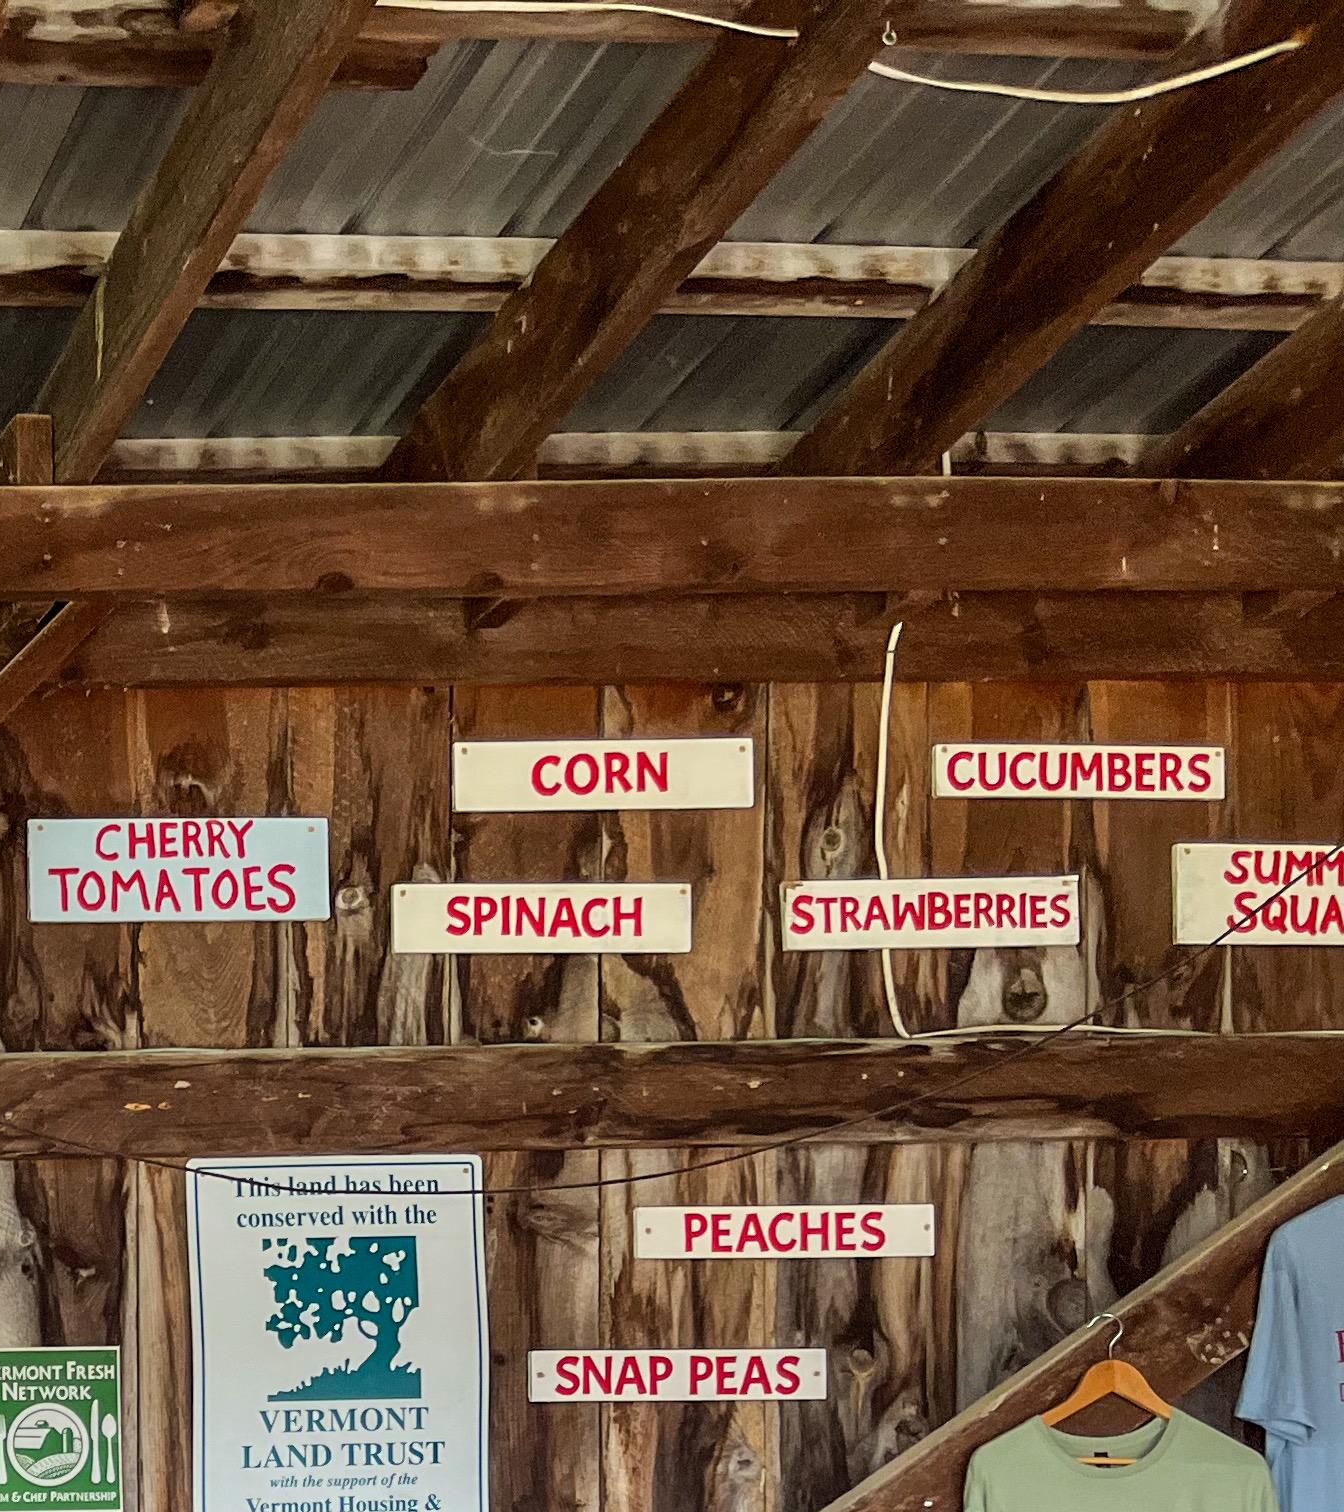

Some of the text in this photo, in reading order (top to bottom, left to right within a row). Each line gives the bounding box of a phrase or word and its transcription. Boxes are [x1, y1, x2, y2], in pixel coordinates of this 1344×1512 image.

[530, 752, 670, 796] CORN
[947, 751, 1211, 792] CUCUMBERS
[95, 819, 253, 863] CHERRY
[49, 864, 296, 914] TOMATOES
[446, 895, 644, 938] SPINACH
[789, 893, 1071, 935] STRAWBERRIES
[234, 1173, 439, 1199] This land has been
[236, 1204, 438, 1229] conserved with the
[684, 1211, 886, 1253] PEACHES
[66, 1360, 115, 1380] FRESH
[555, 1356, 801, 1396] SNAP PEAS
[2, 1382, 92, 1401] NETWORK
[259, 1406, 429, 1433] VERMONT
[240, 1440, 446, 1470] LAND TRUST
[269, 1472, 418, 1491] with the support of the
[11, 1491, 23, 1503] &
[23, 1491, 47, 1503] CHEF
[50, 1491, 117, 1502] PARTNERSHIP
[424, 1493, 442, 1511] &
